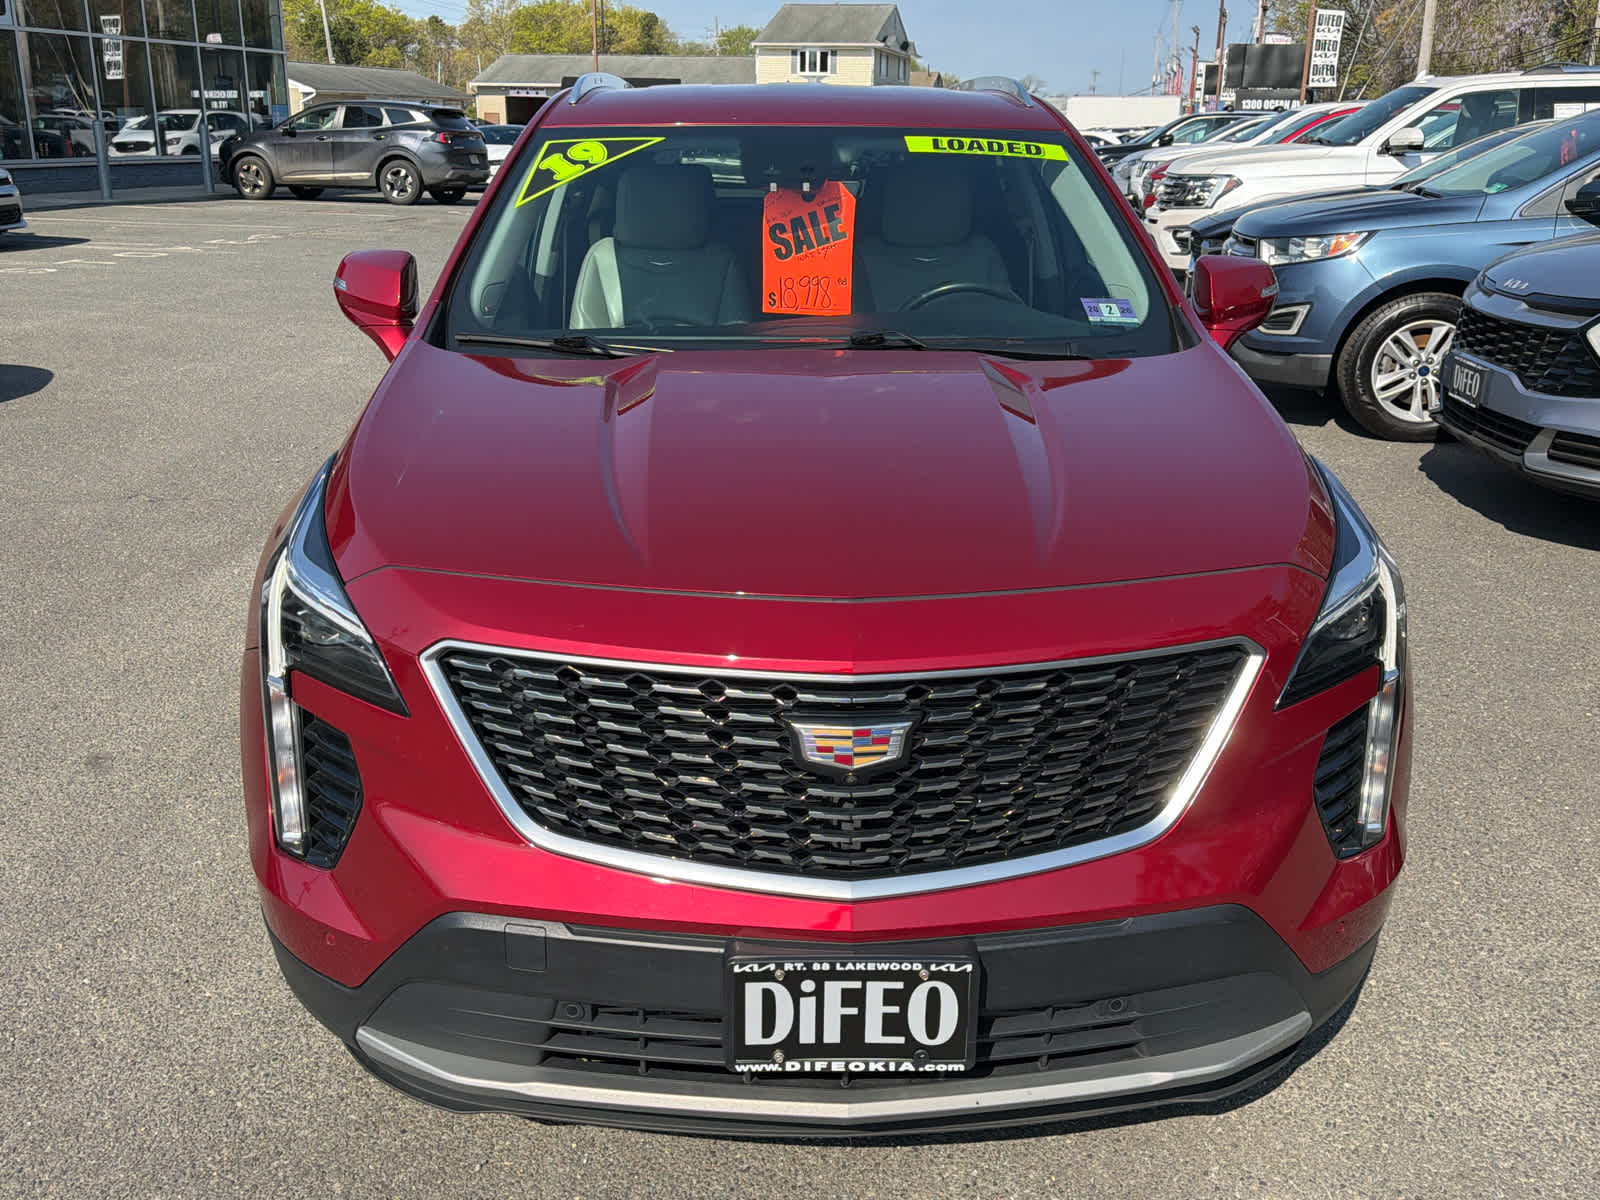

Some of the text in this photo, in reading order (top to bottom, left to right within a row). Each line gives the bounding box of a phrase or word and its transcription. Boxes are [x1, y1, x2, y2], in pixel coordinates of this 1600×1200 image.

[1241, 99, 1262, 110] 1300
[1263, 99, 1291, 110] OCEAN
[931, 138, 1043, 157] LOADED
[538, 140, 608, 181] 19
[768, 203, 848, 261] SALE
[1105, 304, 1113, 315] 2
[1453, 364, 1480, 398] DiFEO
[784, 962, 807, 971] RT.
[812, 962, 830, 971] 88
[836, 962, 922, 971] LAKEWOOD
[744, 979, 959, 1046] DiFEO
[735, 1061, 965, 1072] www.DIFEOKIA.com
